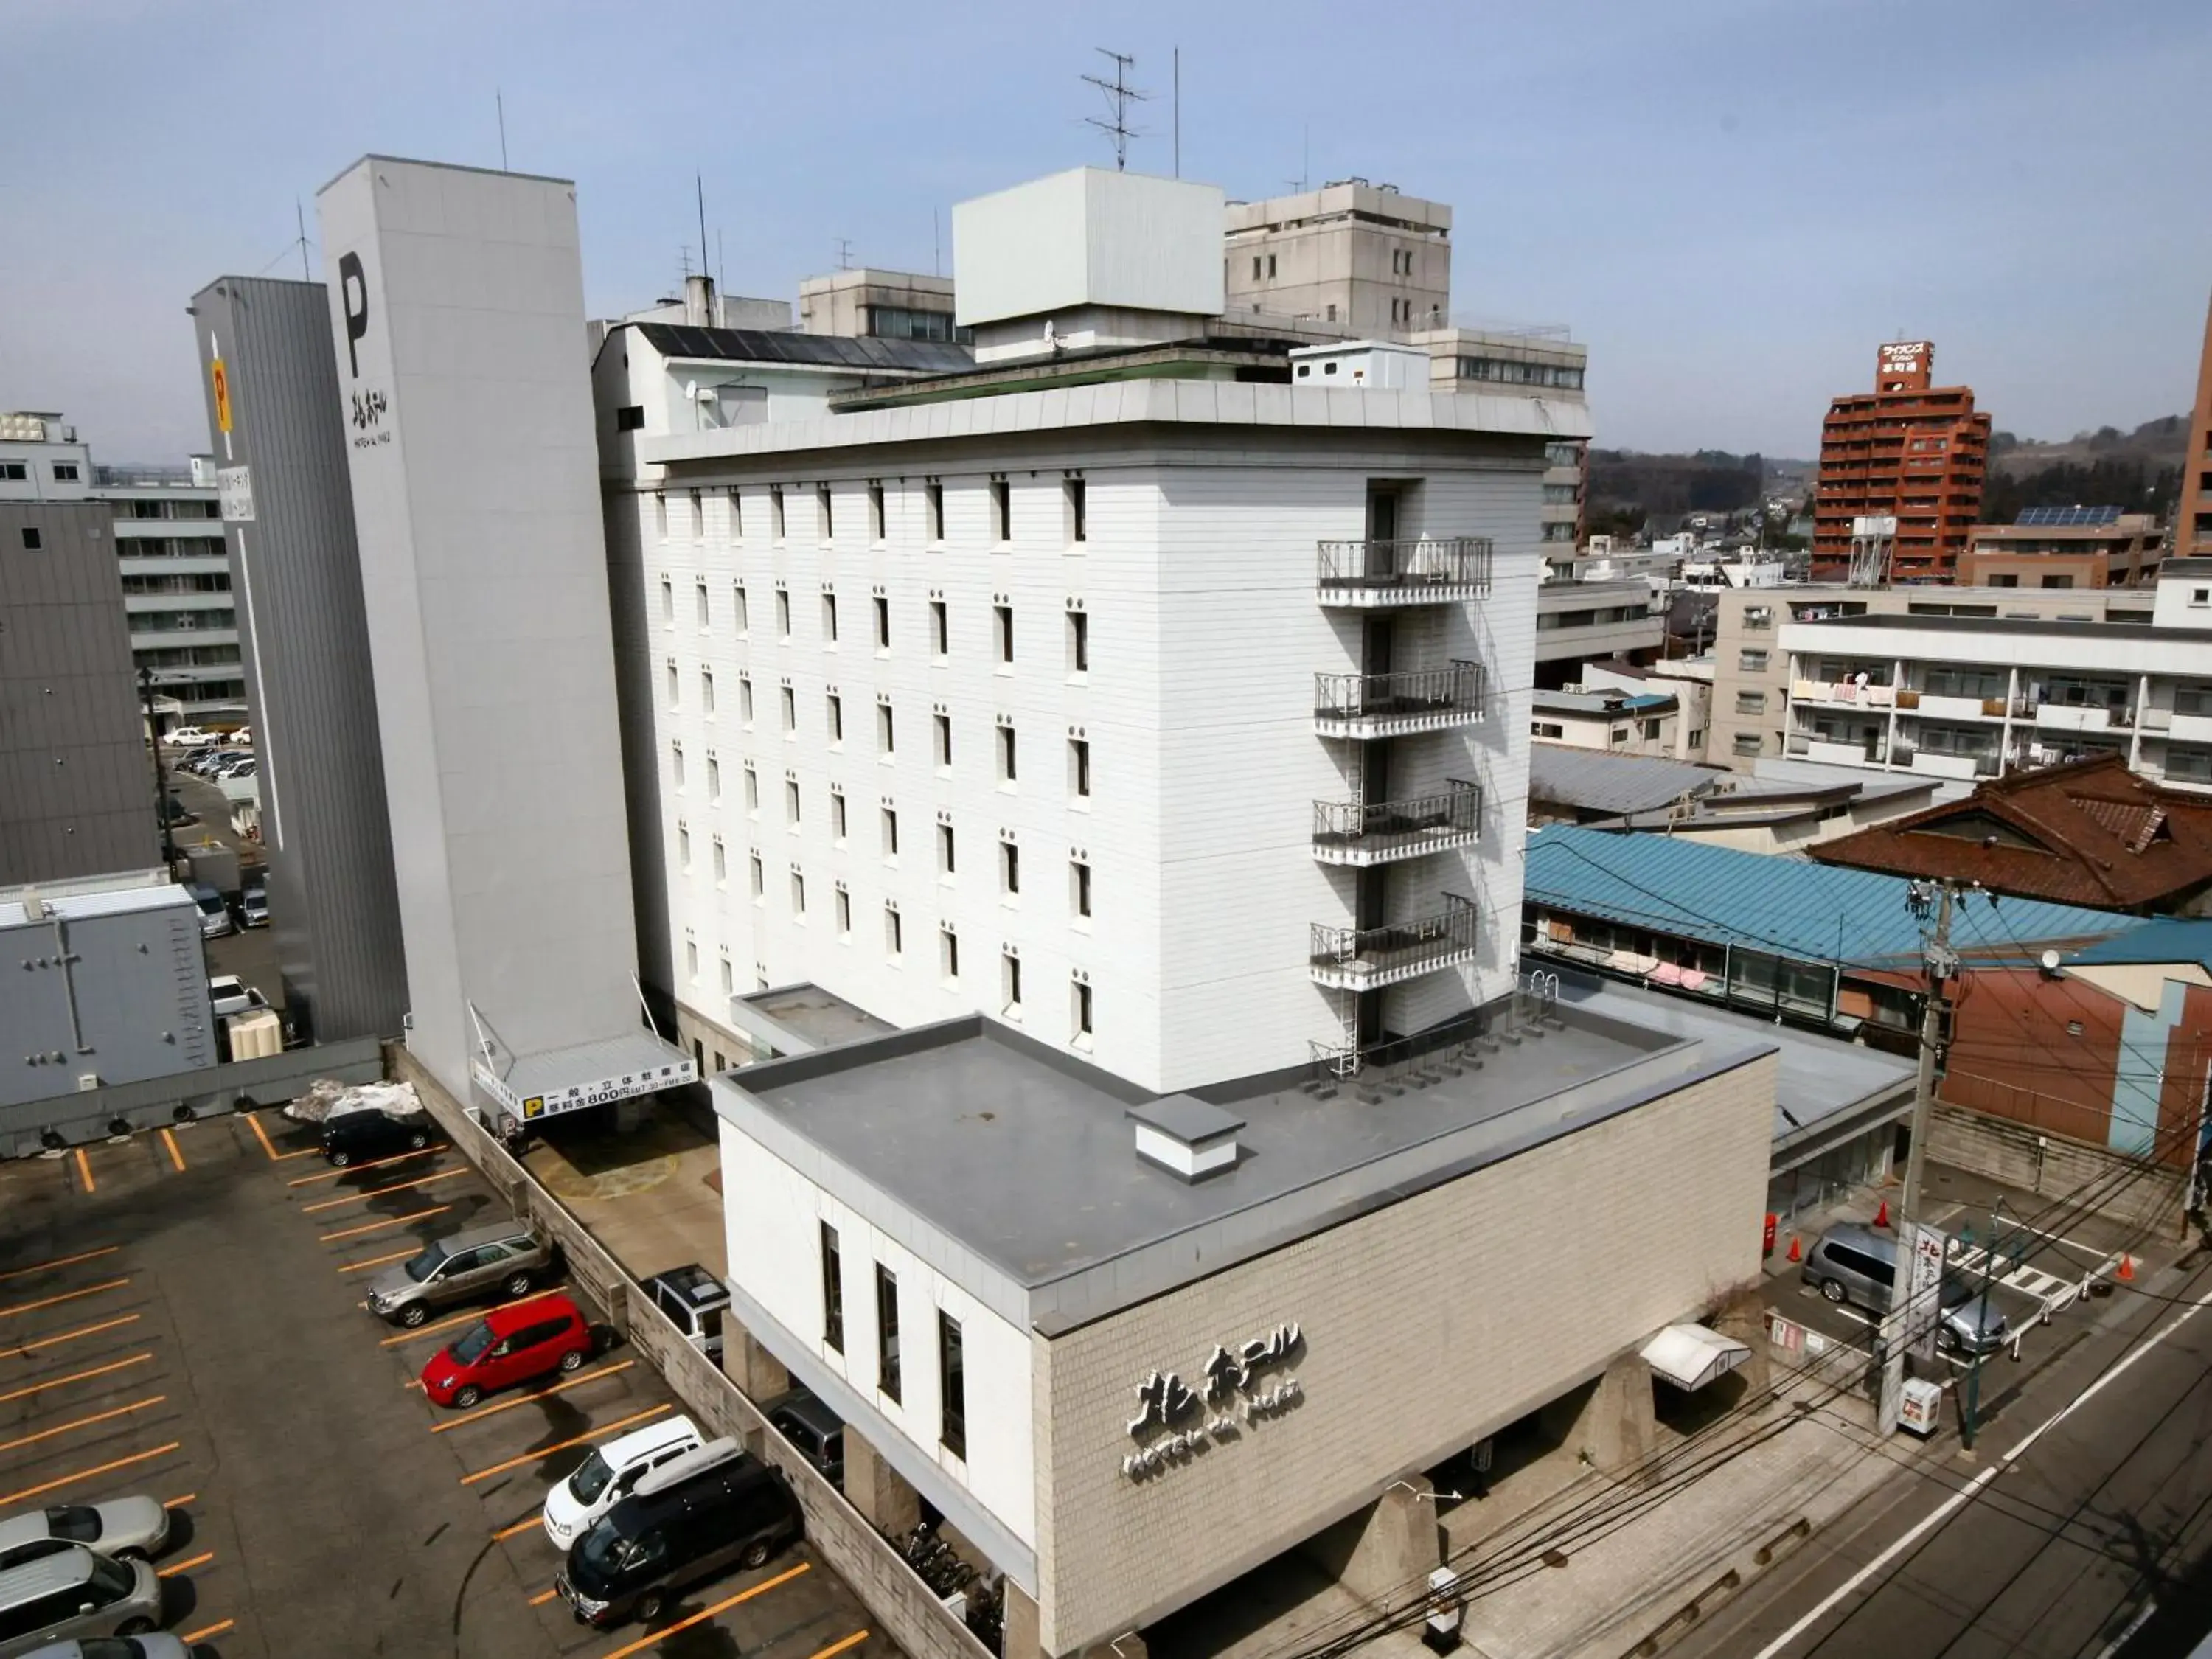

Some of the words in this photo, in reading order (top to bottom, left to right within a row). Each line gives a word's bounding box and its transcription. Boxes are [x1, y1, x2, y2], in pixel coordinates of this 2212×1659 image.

[339, 251, 368, 378] P
[1126, 1321, 1305, 1436] 北ホテル
